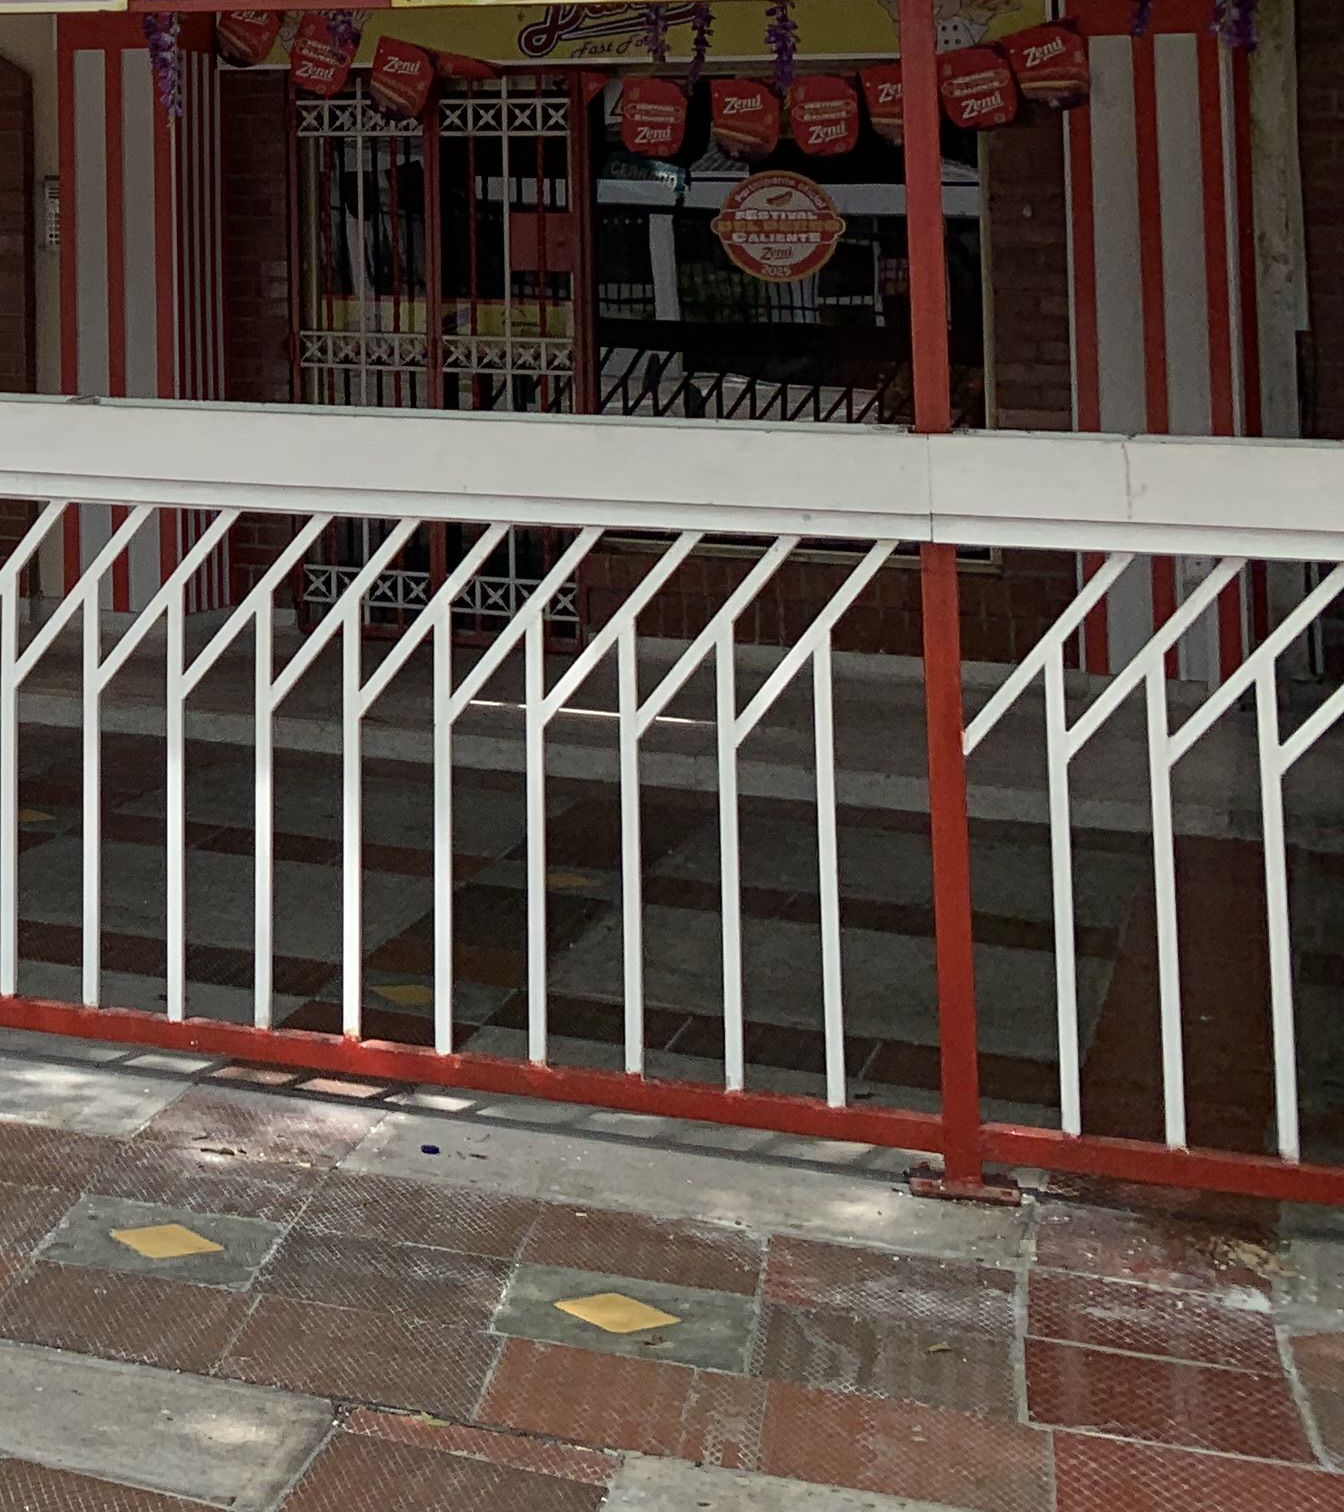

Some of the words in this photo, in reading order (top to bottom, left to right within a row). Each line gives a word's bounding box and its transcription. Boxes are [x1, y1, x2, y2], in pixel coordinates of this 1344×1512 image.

[1022, 34, 1067, 68] Zenú
[381, 55, 422, 76] Zenú
[722, 94, 764, 115] Zenú
[962, 91, 1005, 120] Zenú
[633, 124, 673, 145] Zenú
[807, 120, 849, 145] Zenú
[732, 232, 822, 244] CALIENTE
